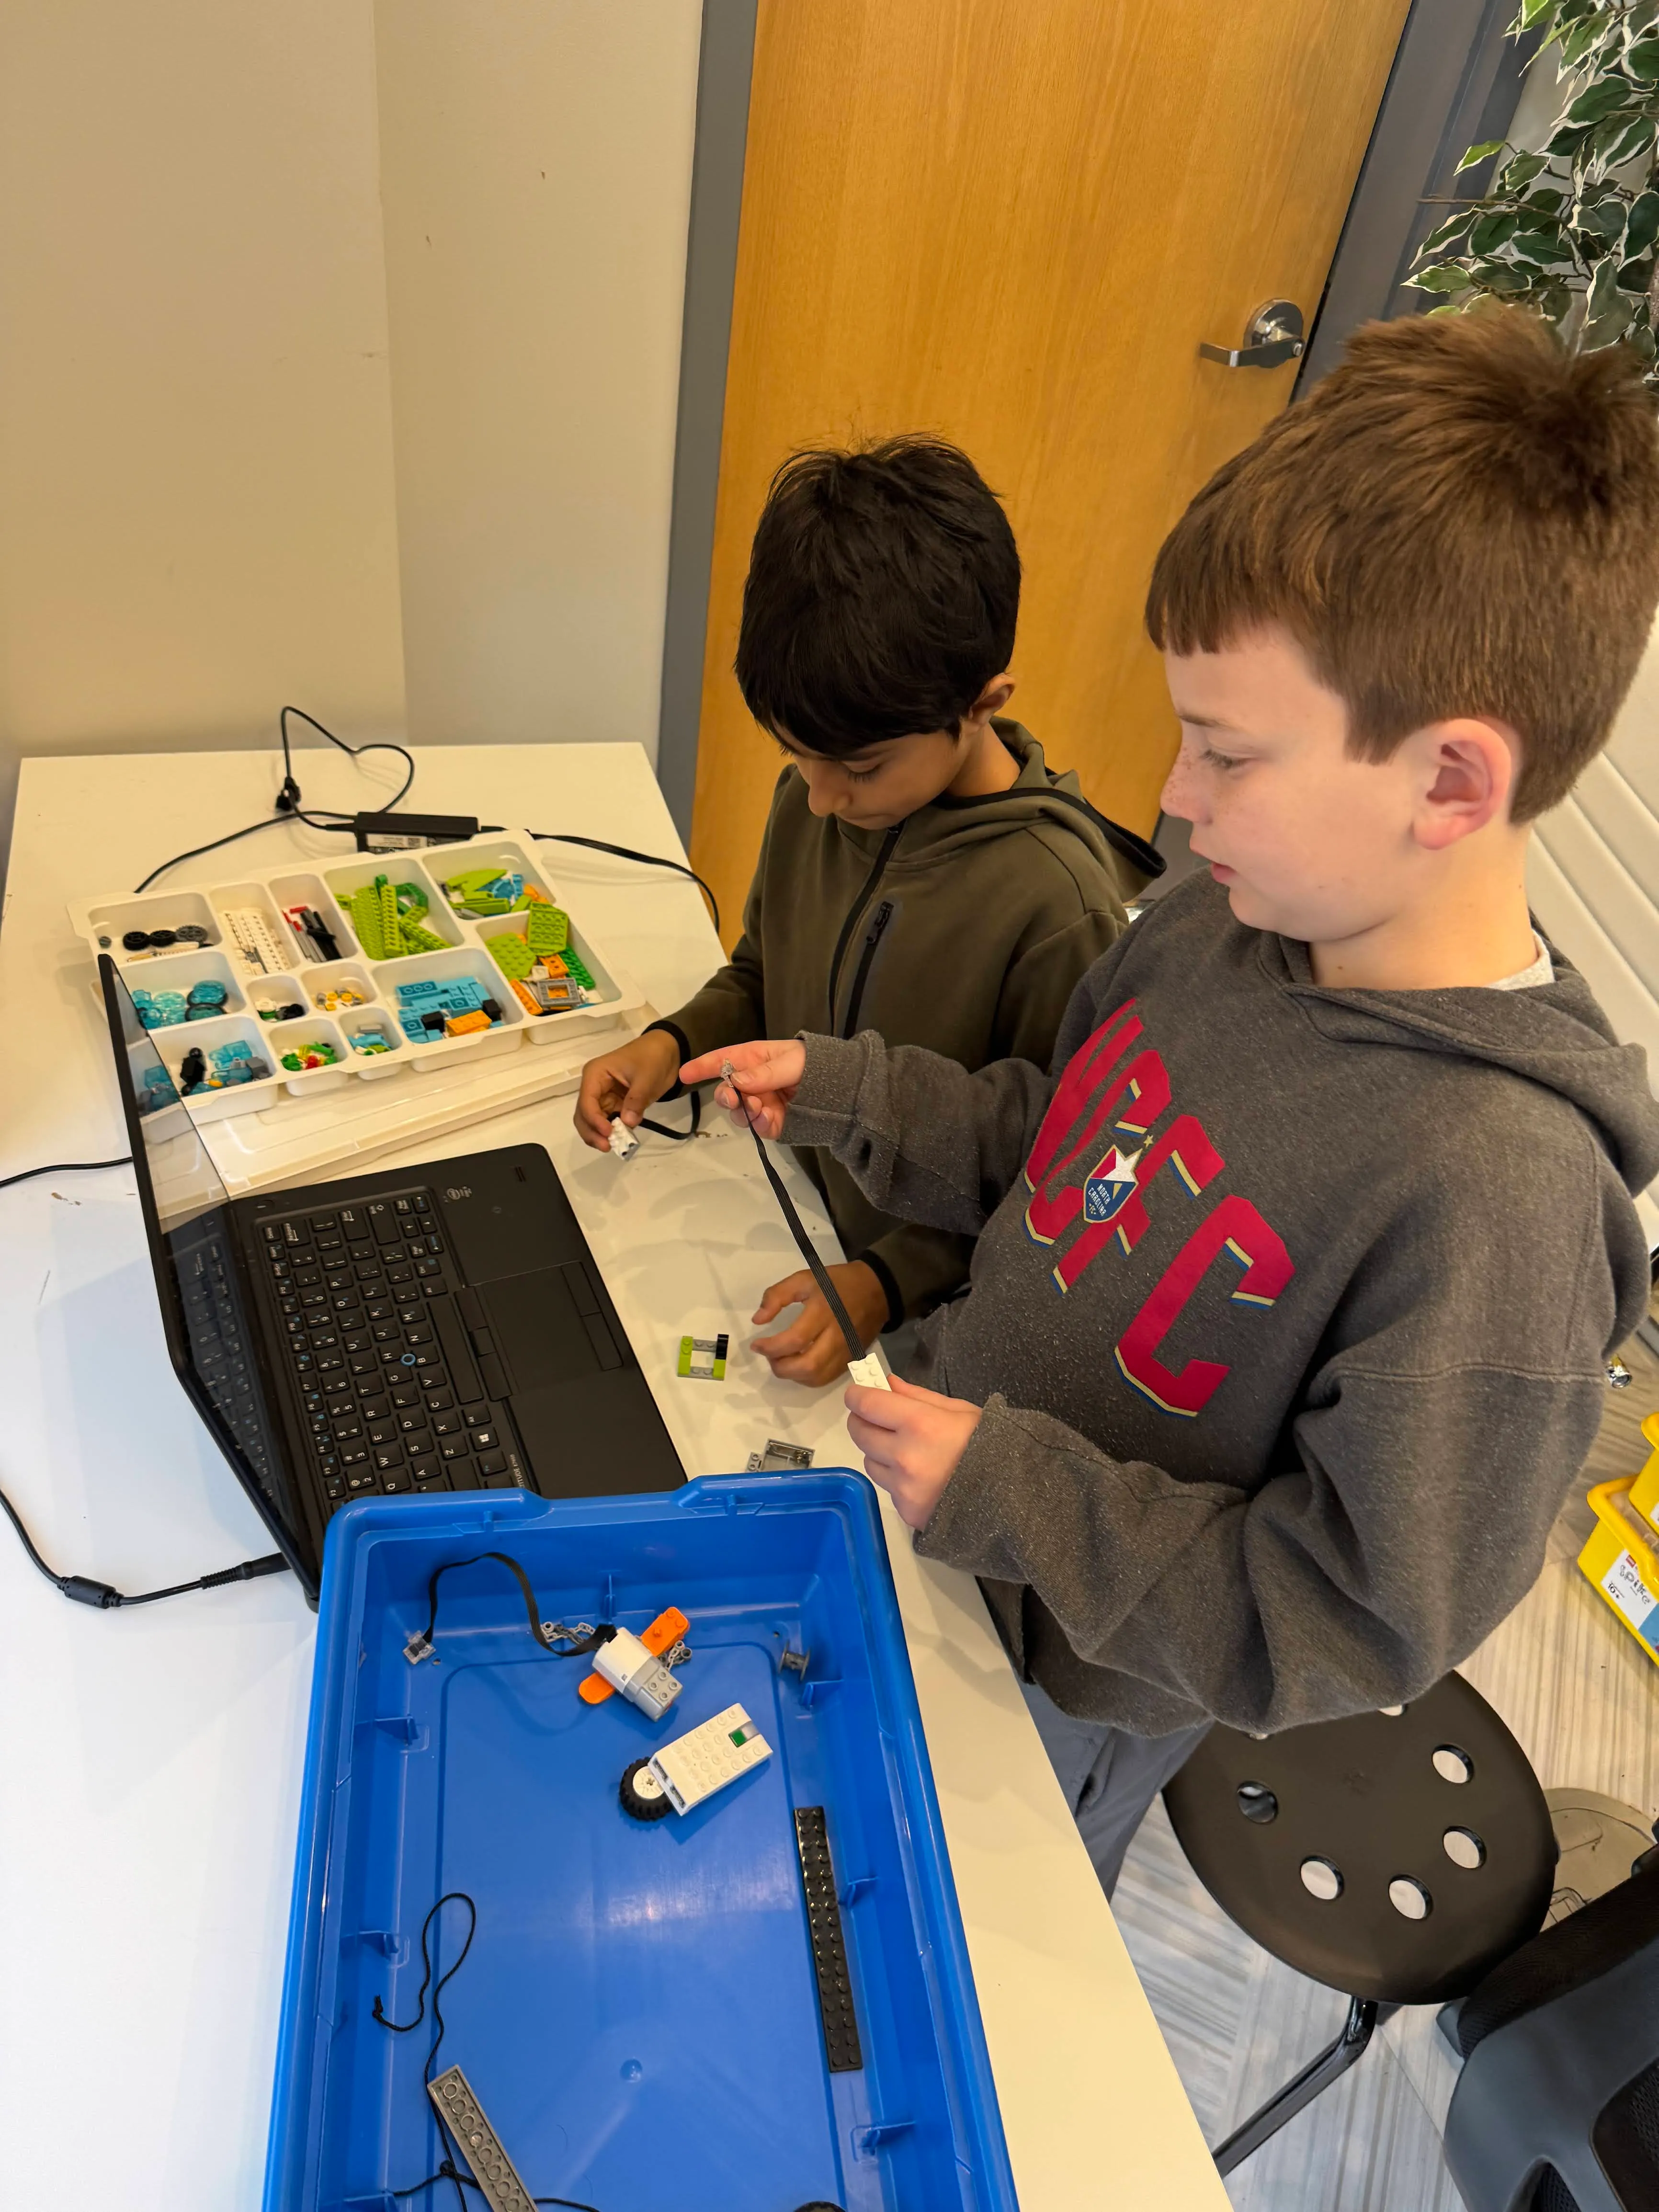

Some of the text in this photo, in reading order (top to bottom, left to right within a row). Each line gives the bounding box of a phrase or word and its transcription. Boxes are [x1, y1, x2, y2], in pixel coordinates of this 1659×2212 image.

[1088, 1187, 1106, 1217] CAROLINA
[1097, 1184, 1111, 1205] NORTH
[380, 1458, 389, 1466] W
